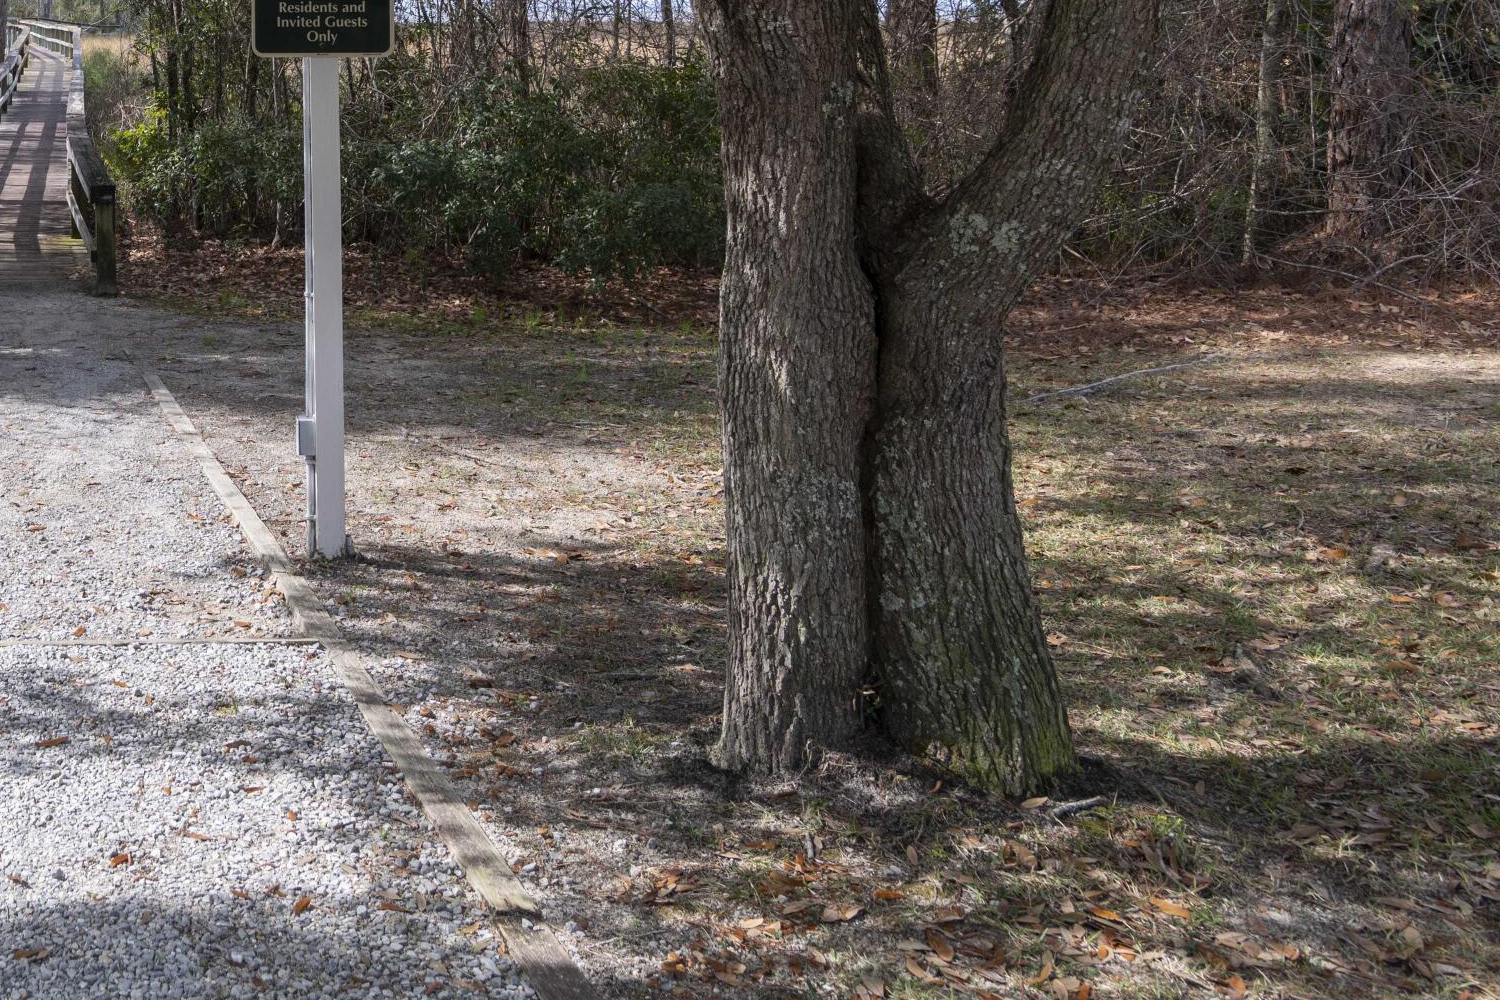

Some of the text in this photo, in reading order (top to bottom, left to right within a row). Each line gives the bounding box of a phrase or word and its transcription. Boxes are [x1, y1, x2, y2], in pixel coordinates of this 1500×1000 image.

[279, 0, 365, 13] Residents and
[276, 15, 368, 28] Invited Guests
[306, 30, 337, 46] Only
